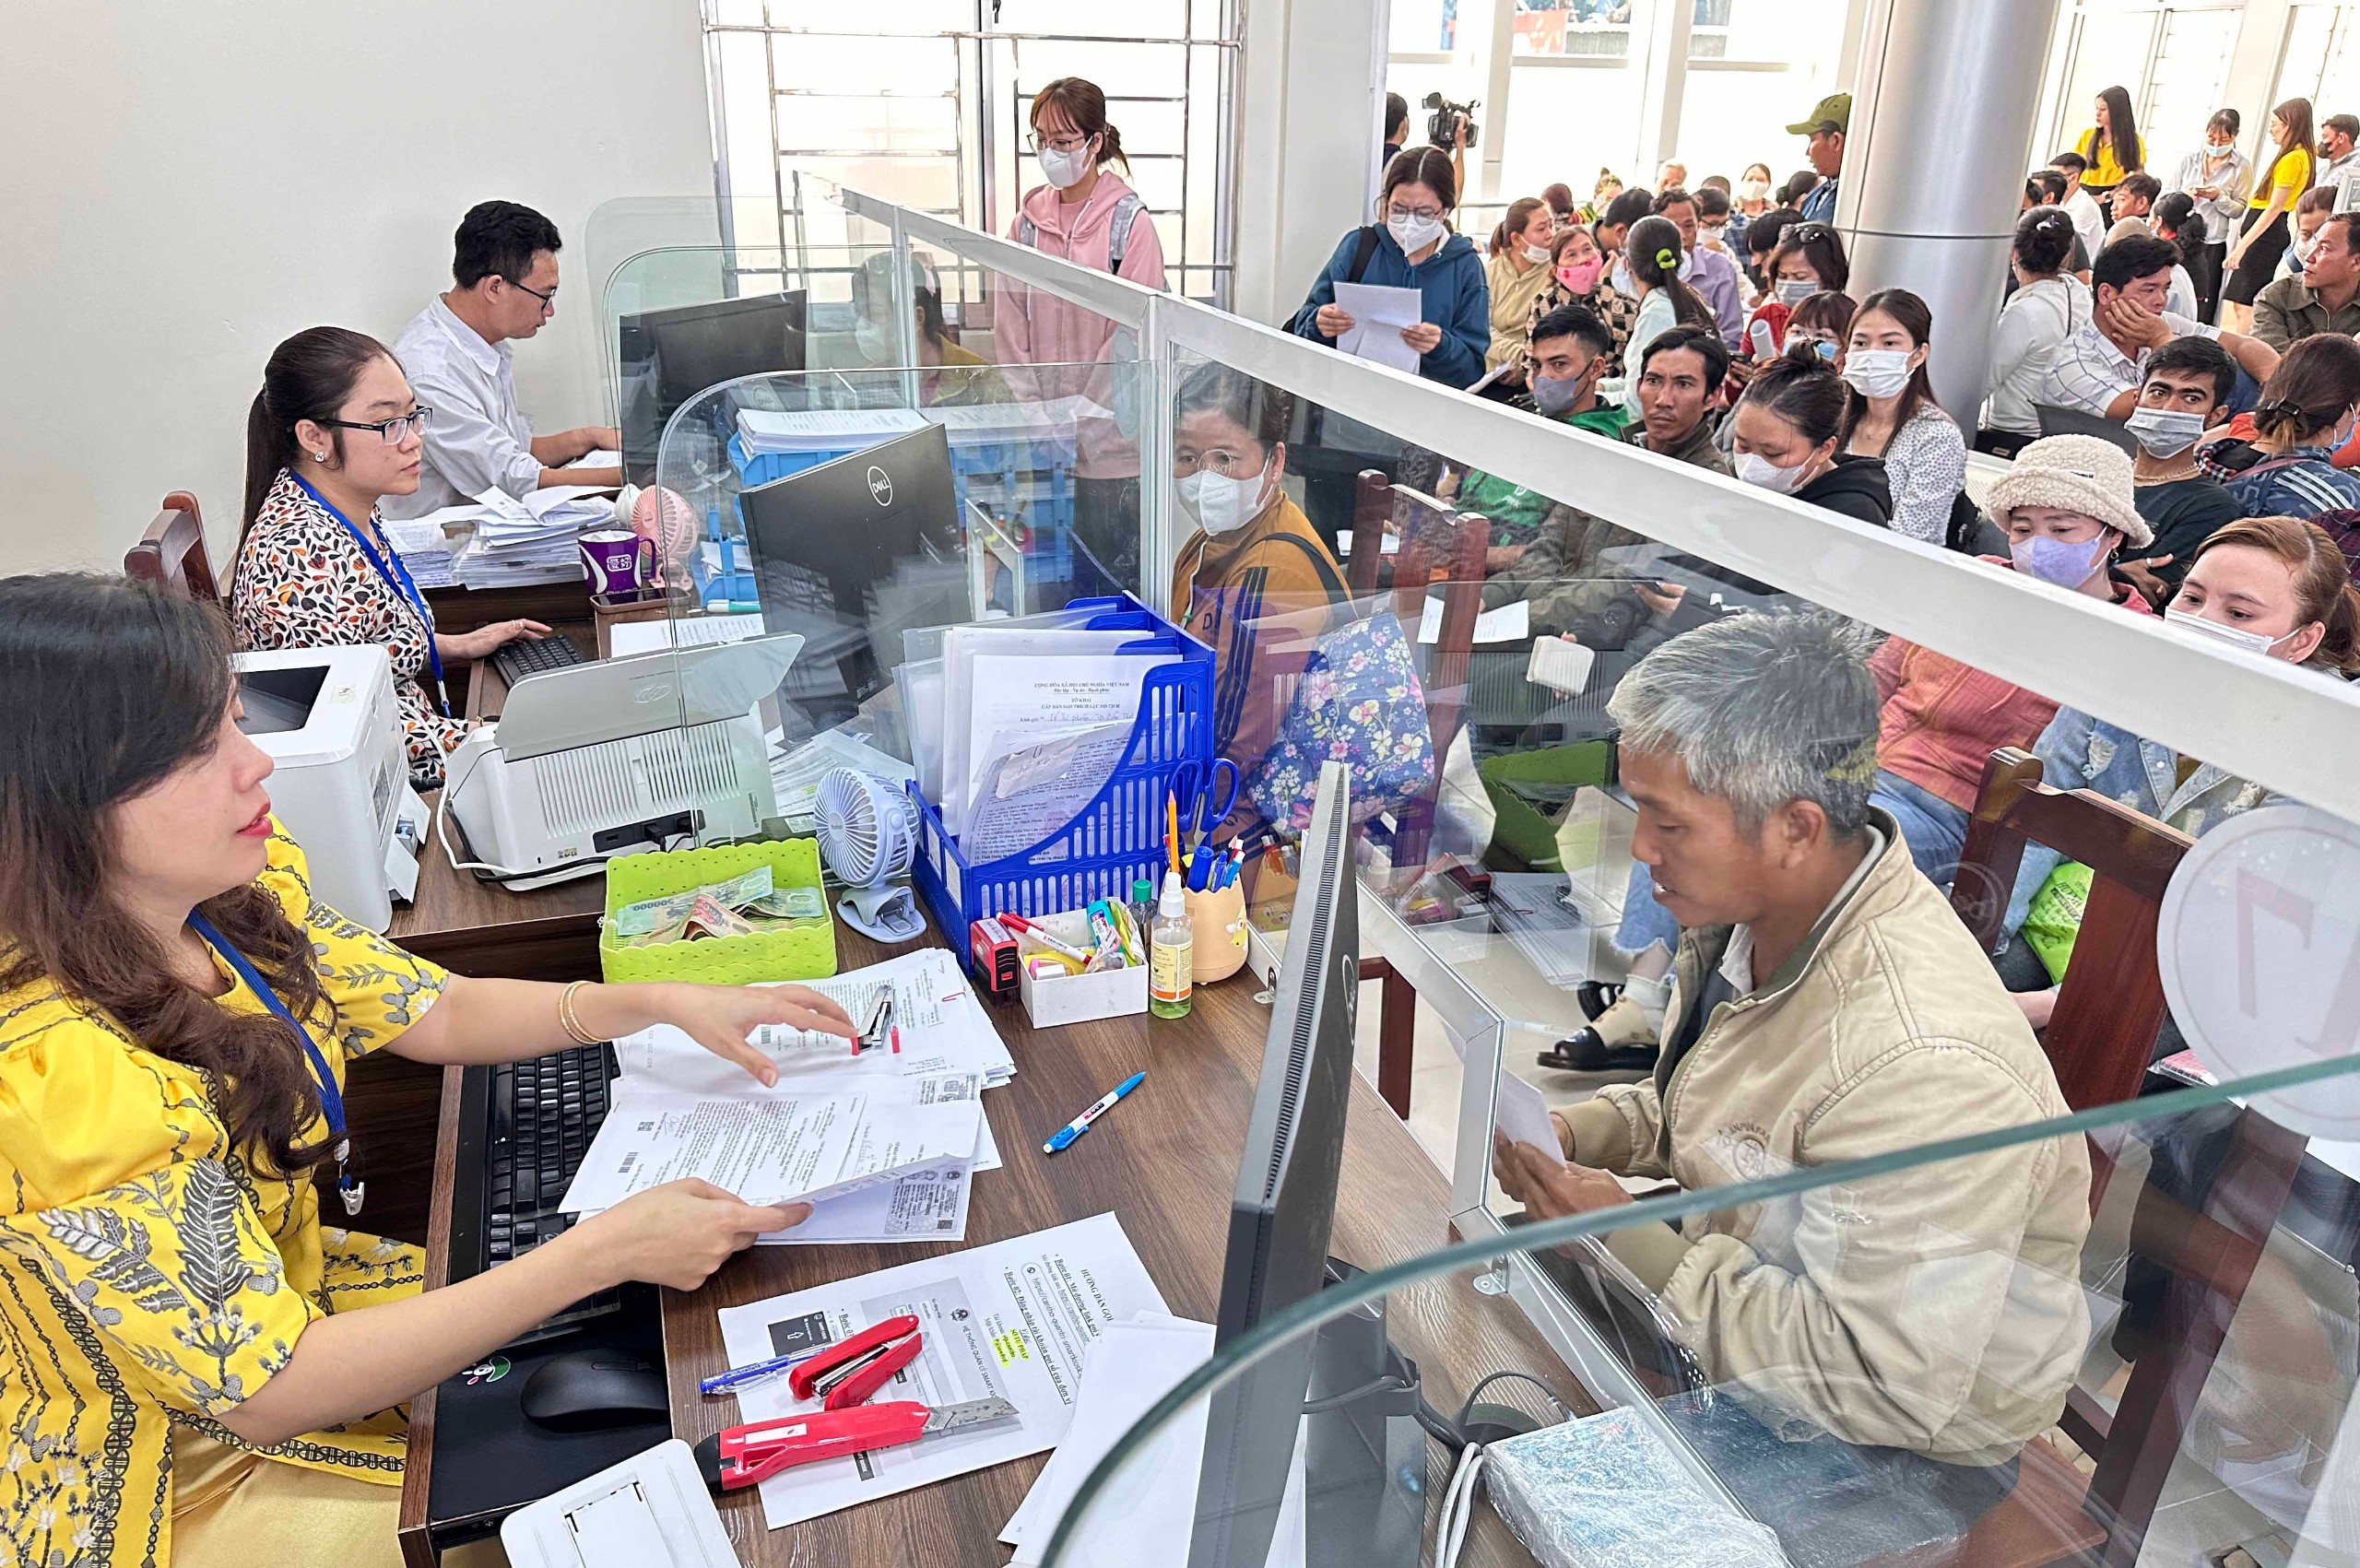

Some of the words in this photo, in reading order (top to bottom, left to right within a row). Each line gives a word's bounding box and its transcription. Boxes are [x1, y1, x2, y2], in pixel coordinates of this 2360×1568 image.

[632, 898, 675, 912] 500000
[1080, 1268, 1098, 1292] HƯỚNG
[1102, 1308, 1114, 1321] GỌI
[981, 1372, 993, 1388] SMART
[1058, 1384, 1068, 1397] đơn
